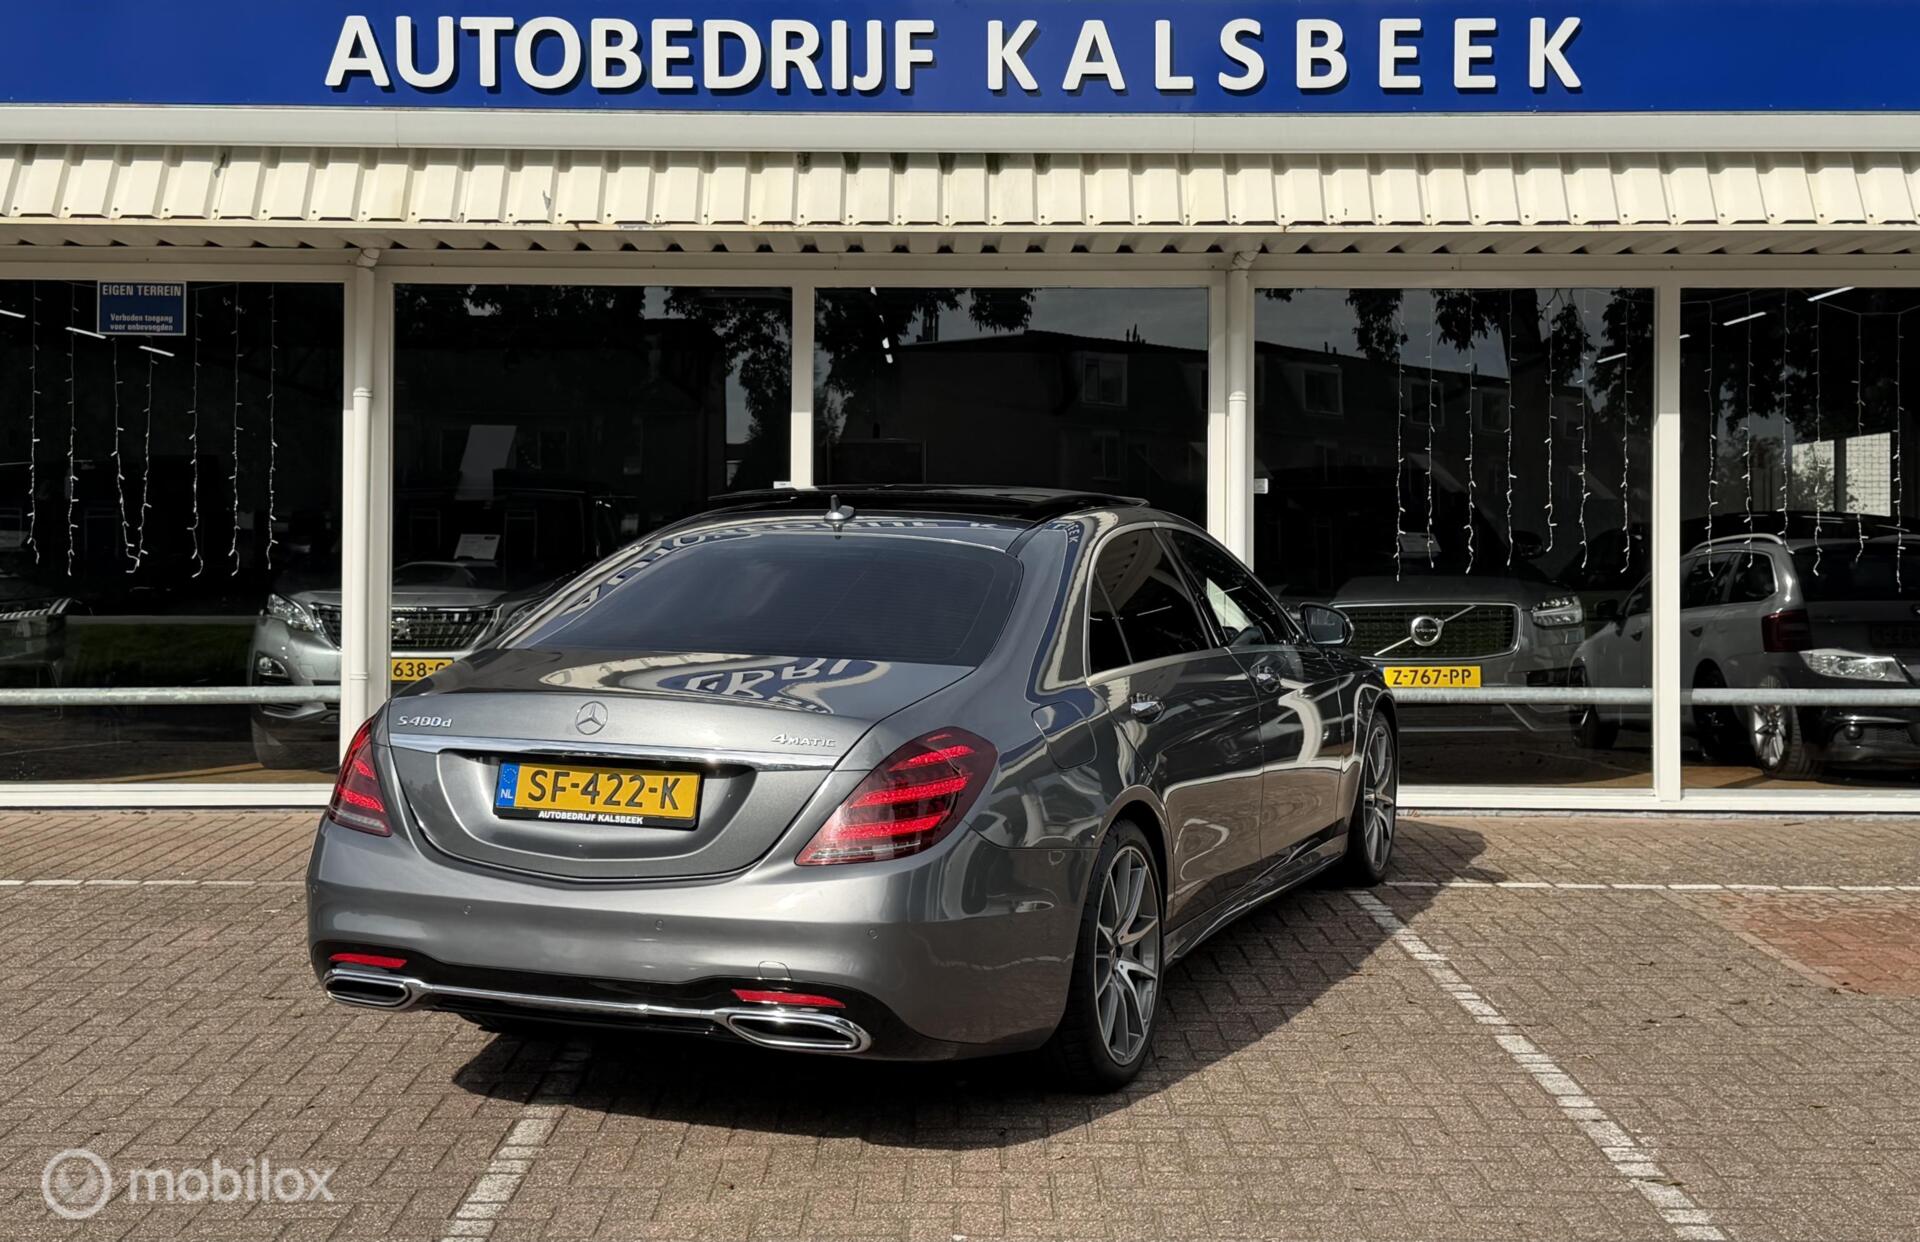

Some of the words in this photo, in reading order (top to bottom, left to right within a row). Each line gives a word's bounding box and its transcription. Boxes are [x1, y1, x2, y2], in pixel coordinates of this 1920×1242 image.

[324, 14, 935, 91] AUTOBEDRIJF
[986, 16, 1582, 91] KALSBEEK
[102, 284, 134, 296] EIGEN
[136, 285, 182, 296] TERREIN
[110, 313, 143, 322] Verboden
[144, 314, 173, 323] toegang
[110, 323, 126, 331] voor
[1392, 668, 1472, 686] Z-767-PP
[500, 788, 514, 800] NL
[527, 768, 681, 811] SF-422-K
[538, 810, 597, 822] AUTOBEDRIJF
[598, 813, 643, 825] KALSBEEK
